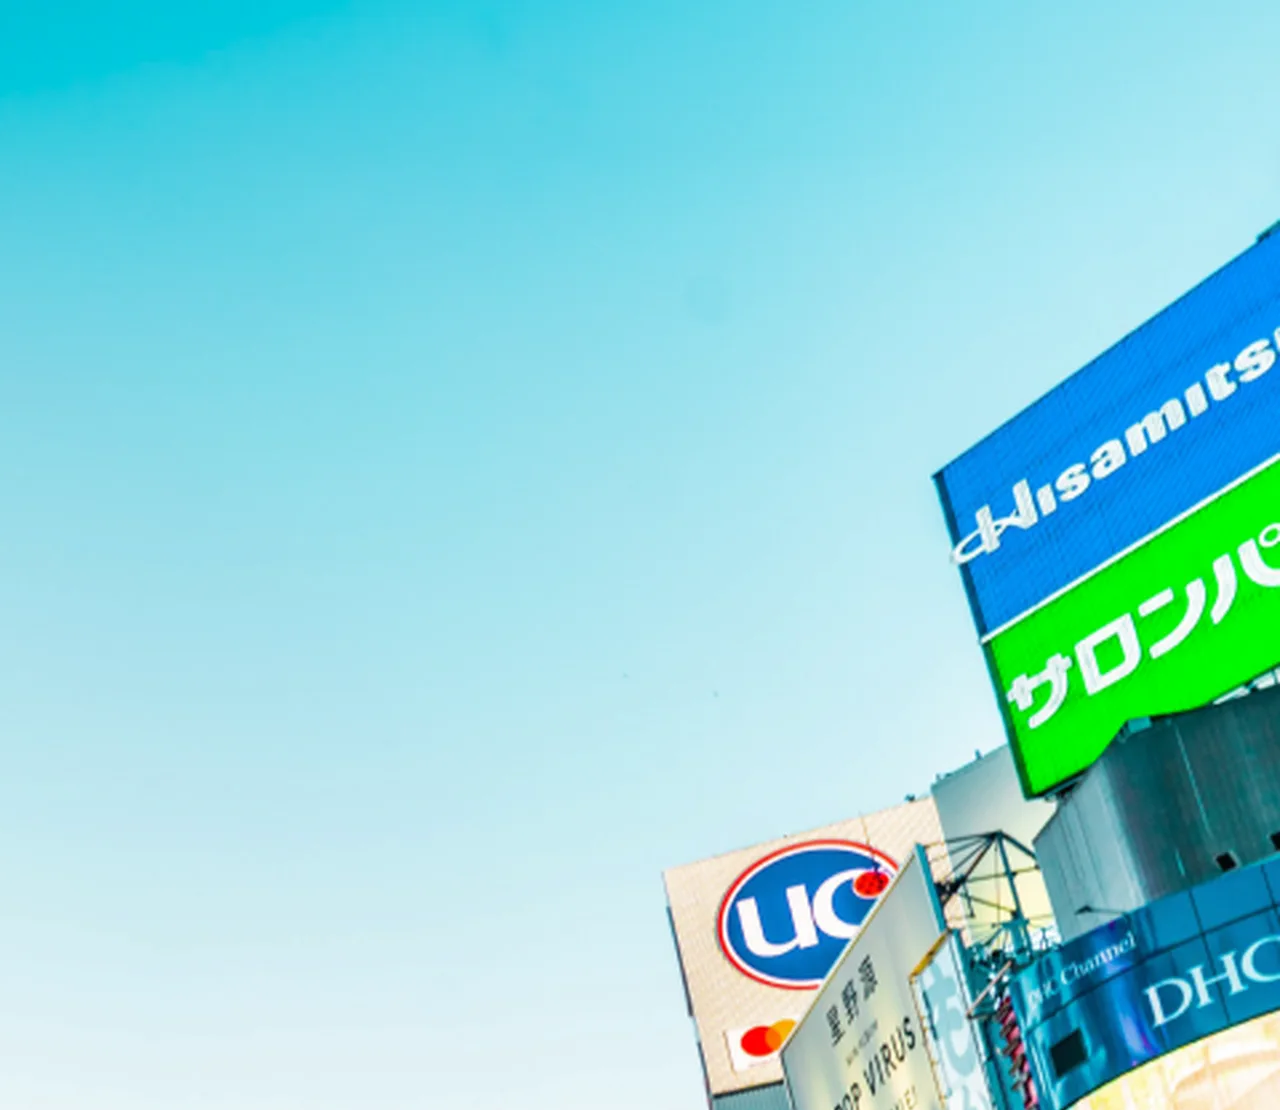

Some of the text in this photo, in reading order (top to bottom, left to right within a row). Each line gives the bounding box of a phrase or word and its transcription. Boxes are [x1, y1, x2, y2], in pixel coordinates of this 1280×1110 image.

[950, 327, 1280, 565] Hisamits
[826, 954, 879, 1047] 星野源
[1060, 931, 1138, 987] Channel
[1143, 934, 1280, 1028] DHC
[863, 1016, 918, 1097] VIRUS
